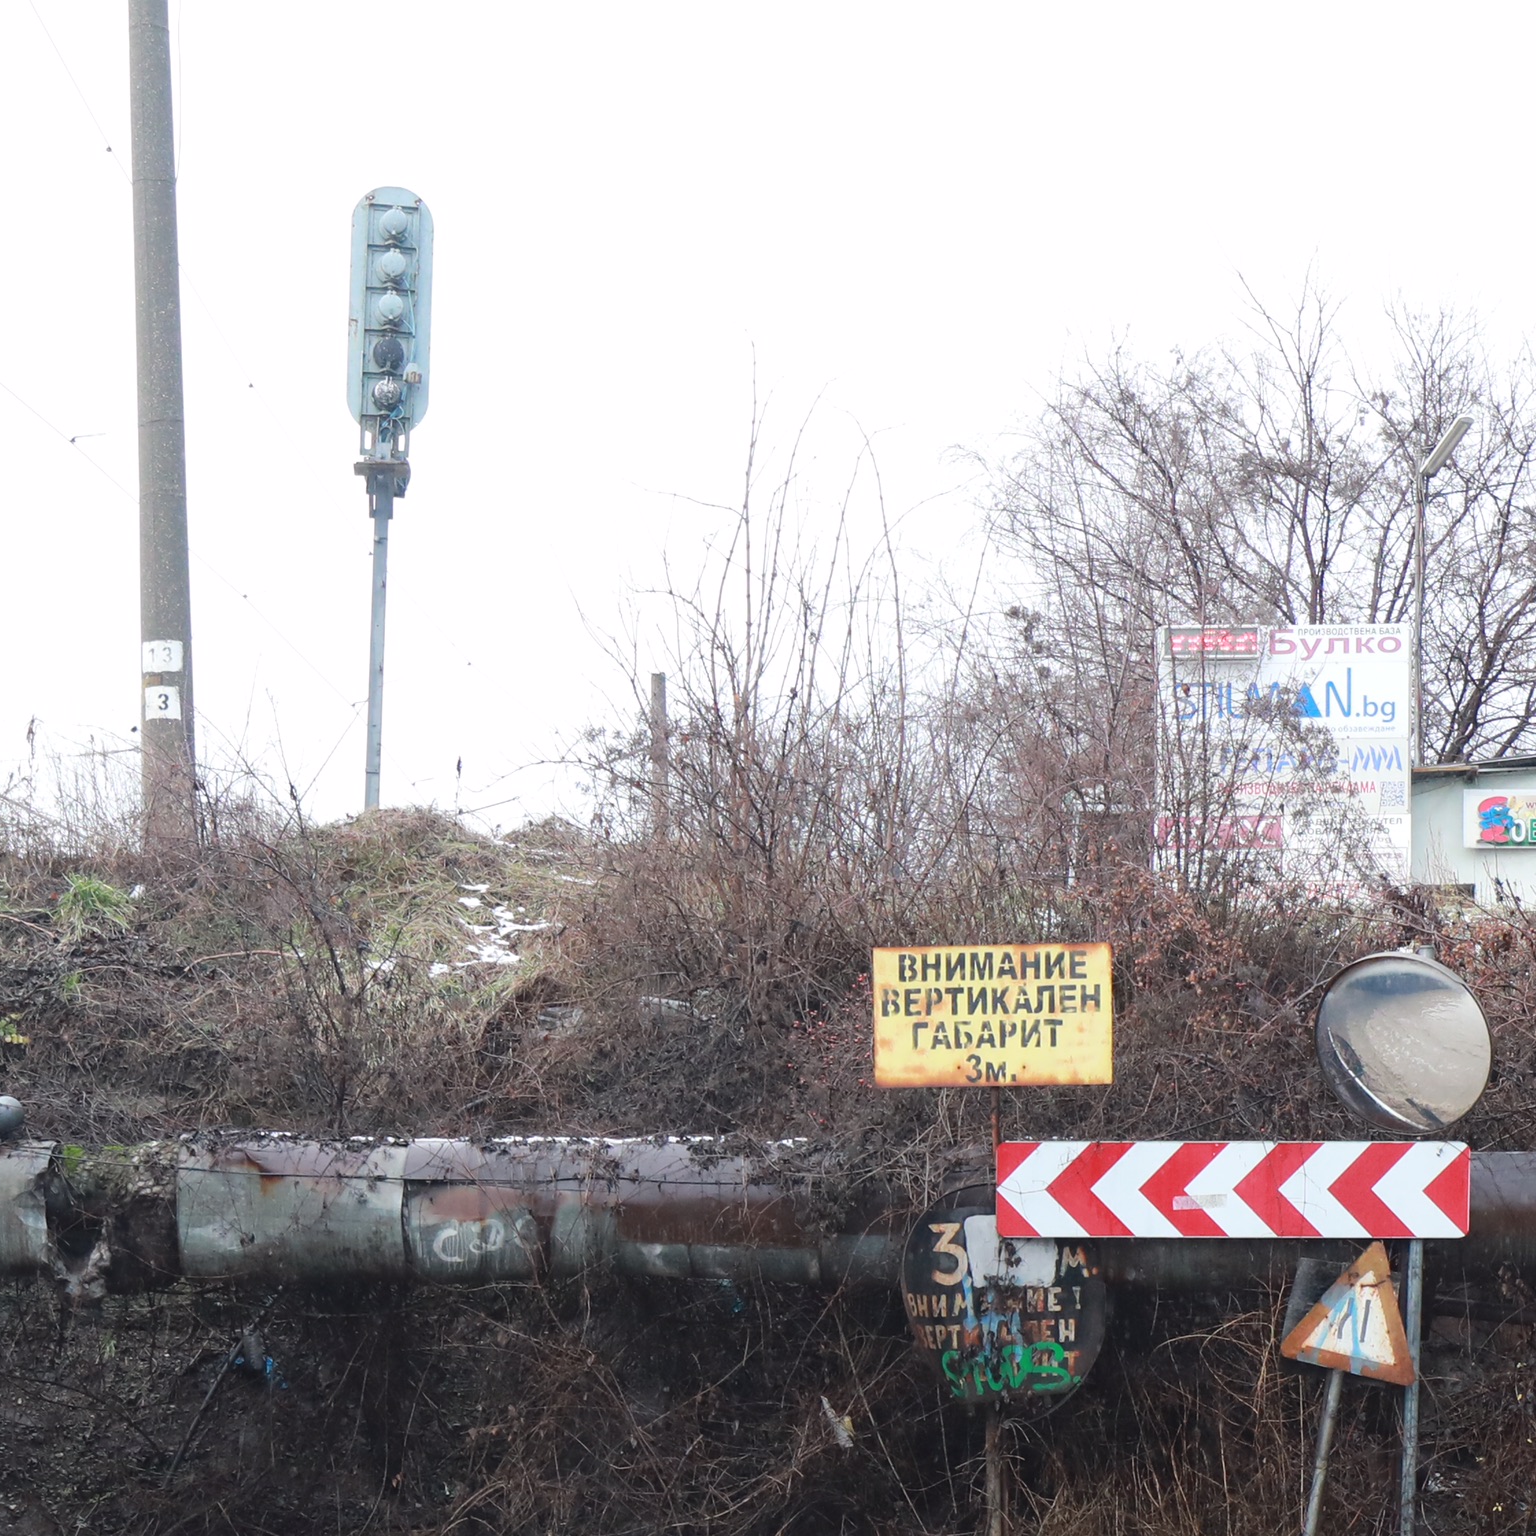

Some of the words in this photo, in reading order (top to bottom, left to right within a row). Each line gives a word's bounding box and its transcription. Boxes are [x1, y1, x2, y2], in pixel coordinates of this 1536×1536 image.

[1269, 629, 1402, 661] Булко
[1298, 627, 1377, 637] ПРОИЗВОДСТВЕНА
[1379, 627, 1402, 635] БАЗА
[148, 647, 172, 662] 13
[158, 693, 169, 710] 3
[897, 950, 1088, 983] ВНИМАНИЕ
[881, 984, 1101, 1017] ВЕРТИКАЛЕН
[911, 1018, 1064, 1050] ГАБАРИТ
